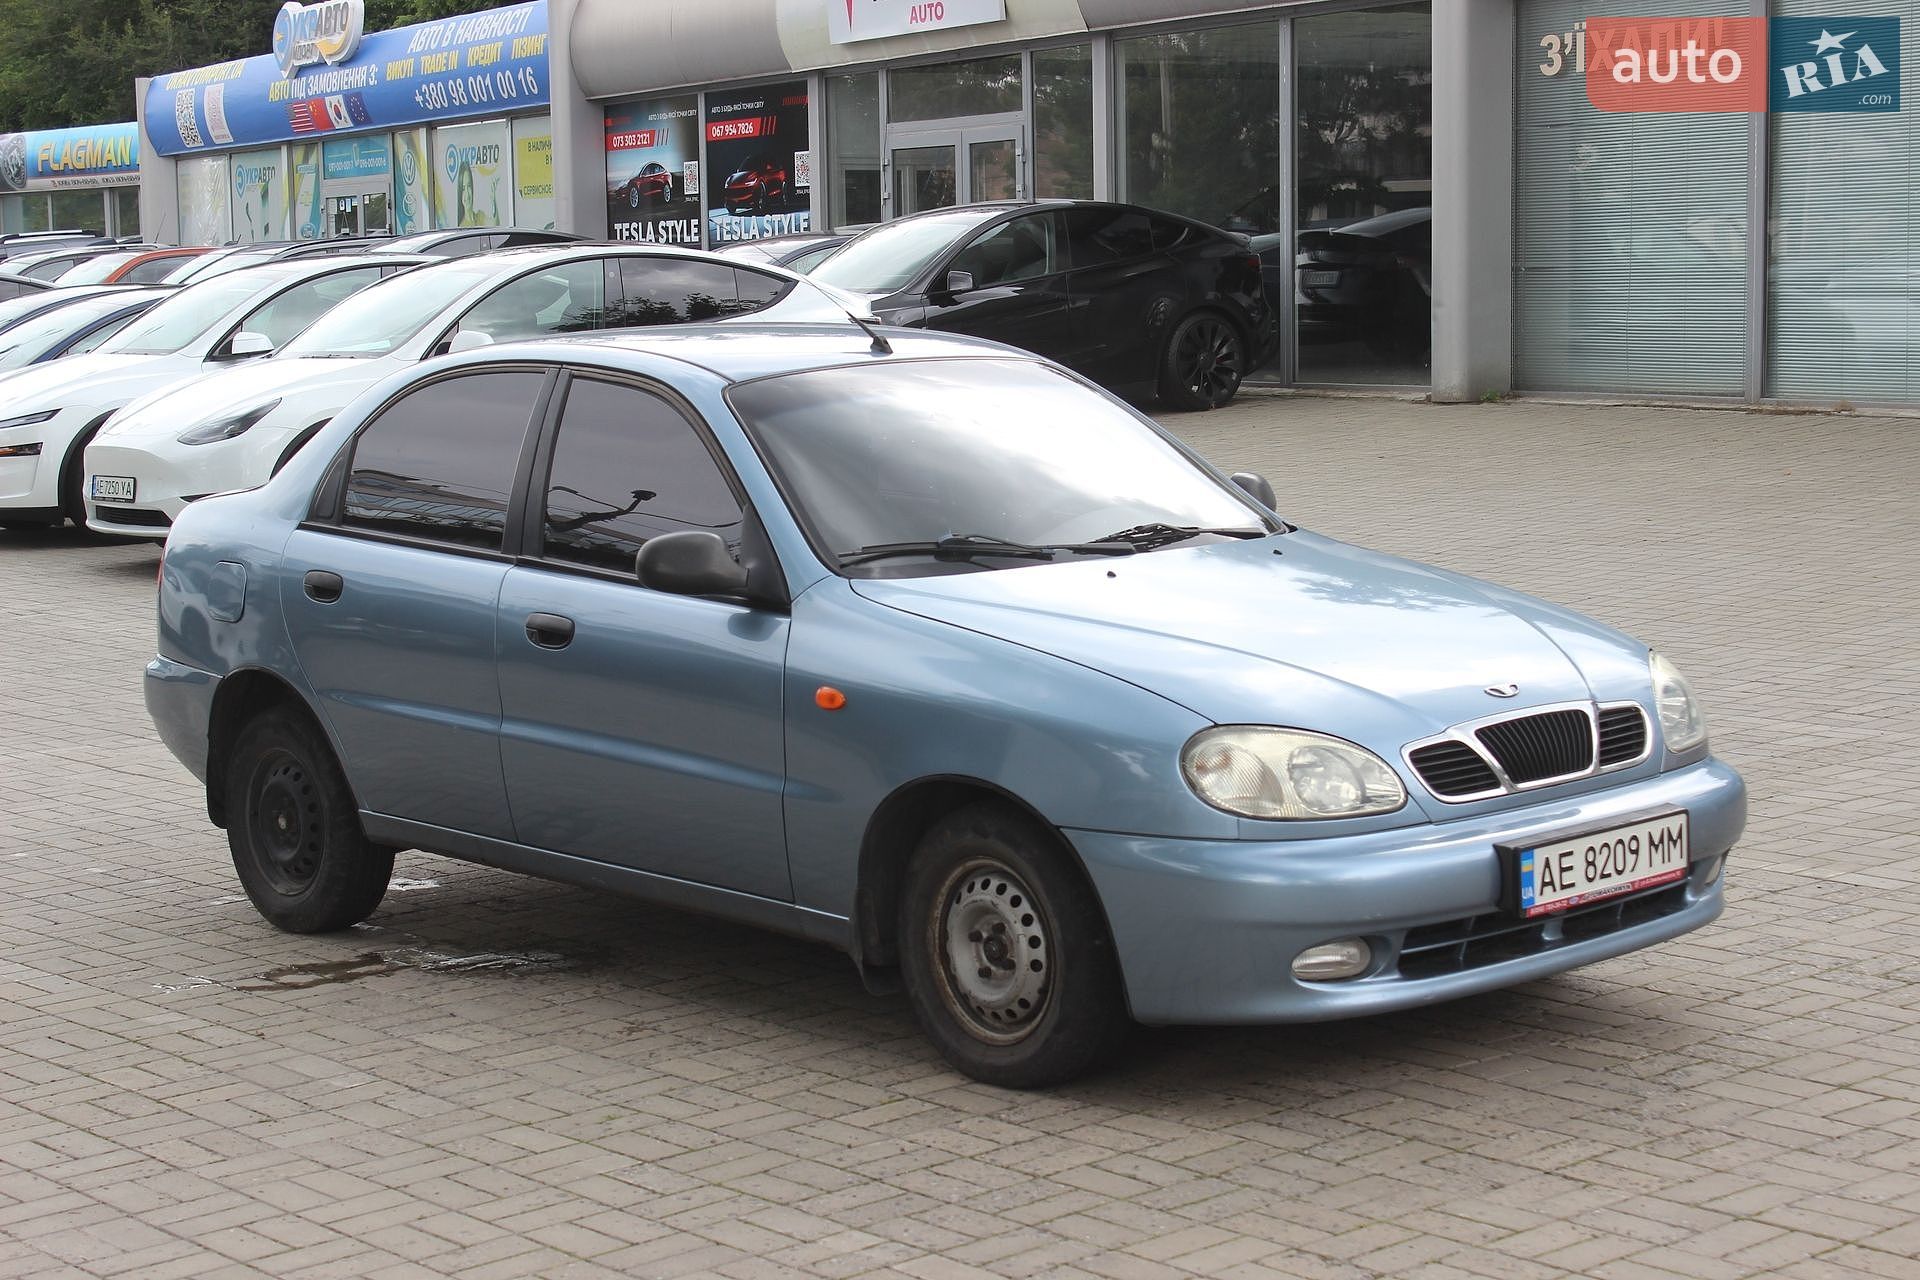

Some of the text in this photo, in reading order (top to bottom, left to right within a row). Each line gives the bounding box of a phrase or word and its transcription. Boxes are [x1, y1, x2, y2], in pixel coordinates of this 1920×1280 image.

[909, 1, 944, 25] AUTO
[407, 6, 533, 53] АВТО В НАЯВНОСТІ
[386, 34, 547, 81] ВИКУП TRADE IN КРЕДИТ ЛІЗИНГ
[269, 80, 289, 102] АВТО
[291, 77, 306, 99] ПІД
[307, 66, 367, 96] ЗАМОВЛЕННЯ
[415, 66, 538, 110] +380 98 001 00 16
[612, 132, 650, 148] 073 303 2121
[712, 122, 753, 138] 067 954 7826
[37, 136, 133, 172] FLAGMAN
[459, 144, 500, 165] УКРАВТО
[245, 166, 275, 184] УКРАВТО
[614, 219, 699, 244] TESLA STYLE
[715, 213, 808, 241] TESLA STYLE
[104, 480, 119, 495] 7250
[1540, 851, 1576, 896] AE
[1584, 835, 1640, 883] 8209
[1648, 823, 1683, 868] MM
[1521, 886, 1534, 900] UA
